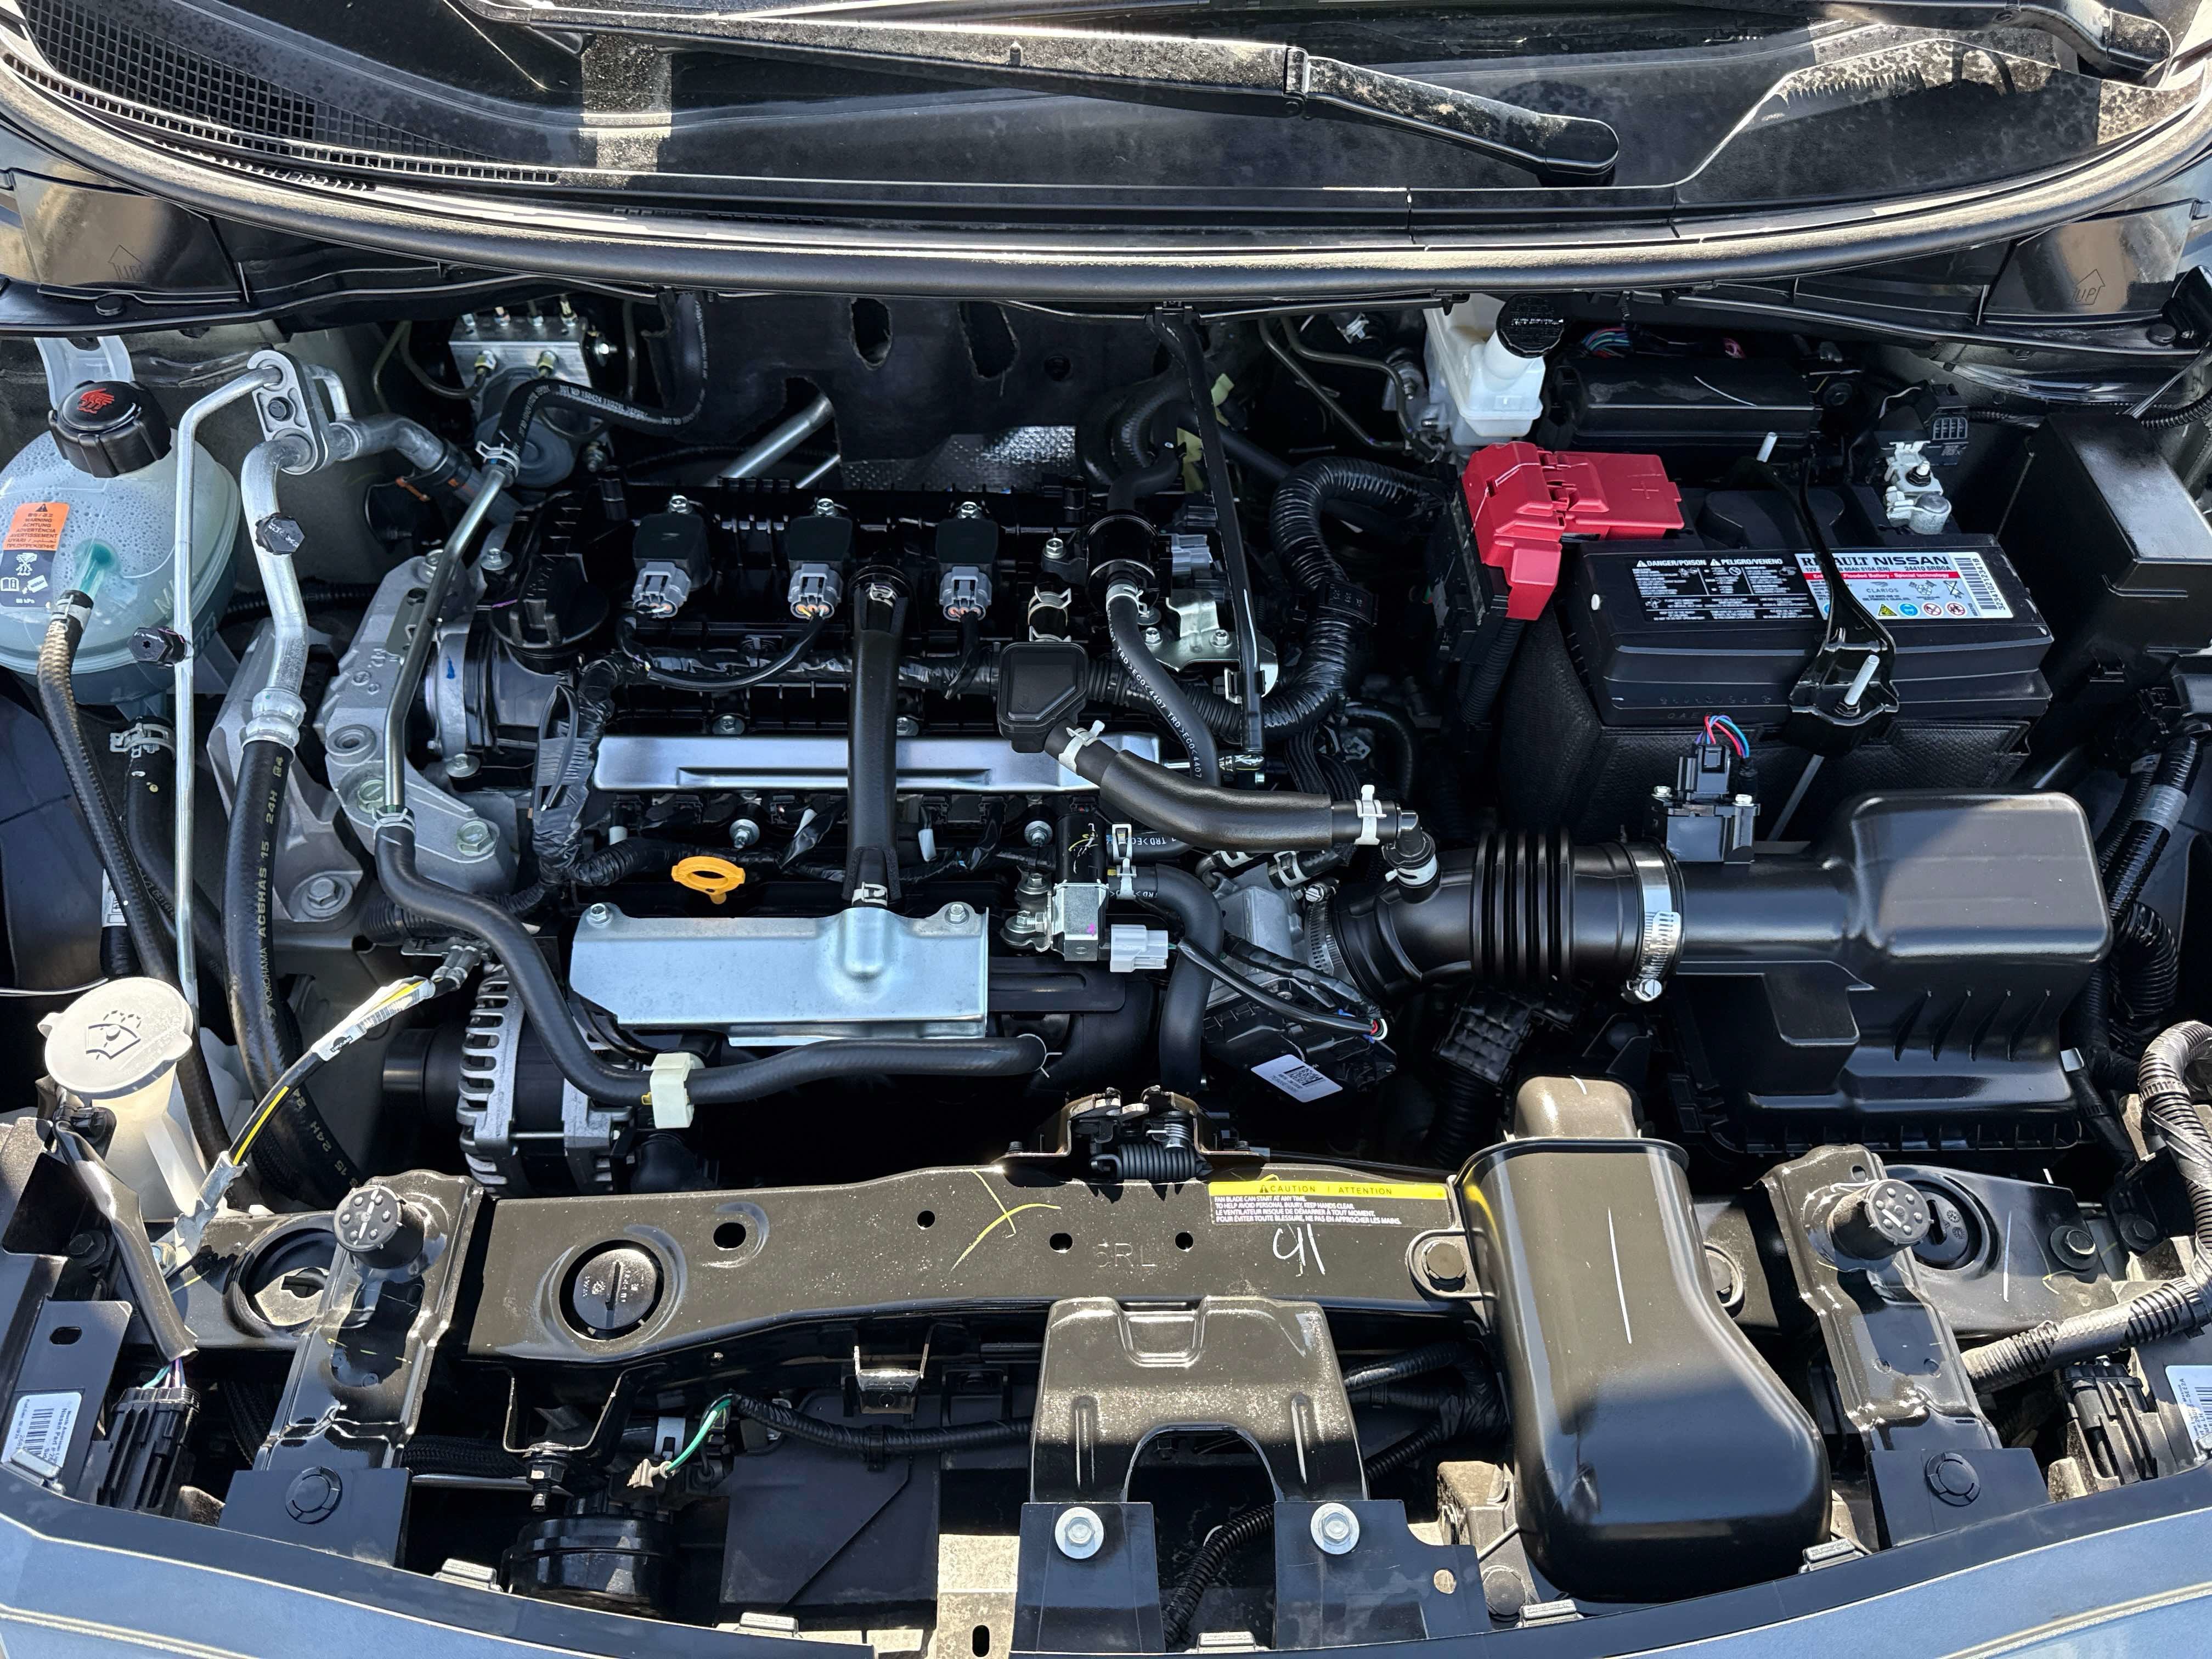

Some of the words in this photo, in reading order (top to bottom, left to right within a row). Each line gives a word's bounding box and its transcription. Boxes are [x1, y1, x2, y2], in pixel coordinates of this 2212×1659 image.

[1873, 556, 1949, 565] NISSAN
[266, 790, 278, 825] 24H
[261, 840, 269, 859] 15
[259, 947, 273, 1006] YOKOHAMA
[1339, 1187, 1392, 1195] ATTENTION
[57, 1408, 67, 1429] Nissan
[52, 1432, 60, 1444] Part
